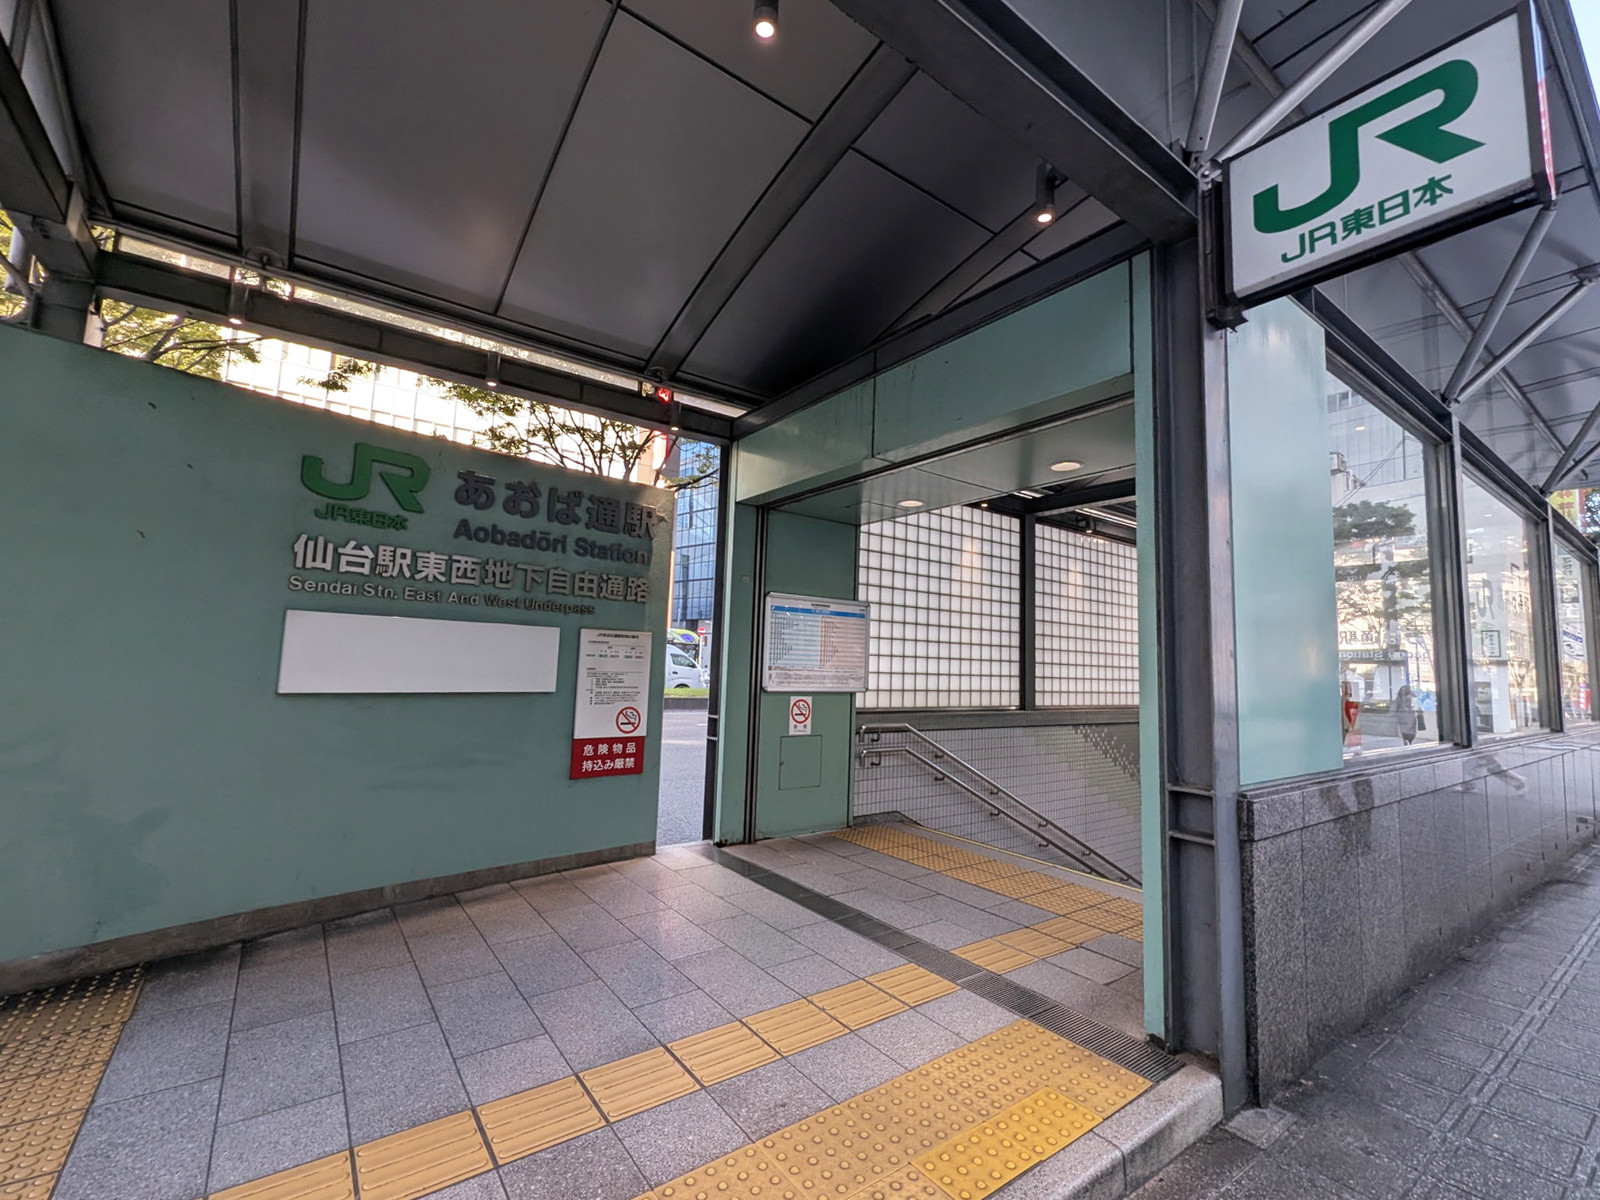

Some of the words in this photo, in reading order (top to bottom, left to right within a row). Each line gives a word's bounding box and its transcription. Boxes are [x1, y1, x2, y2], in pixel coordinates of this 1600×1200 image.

[1253, 59, 1486, 234] JR
[1280, 174, 1453, 263] JR東日本
[301, 442, 430, 514] JR
[454, 470, 658, 540] あおば通駅
[314, 502, 409, 531] JR東日本
[293, 533, 650, 604] 仙台駅東西地下自由通路
[574, 537, 651, 565] Station
[289, 575, 357, 595] Sendai
[363, 583, 398, 599] Stn.
[404, 587, 441, 602] East
[448, 591, 479, 606] And
[484, 594, 520, 608] West
[524, 598, 596, 615] Underpass
[582, 758, 635, 772] 持込み厳禁
[583, 742, 636, 757] 危険物品
